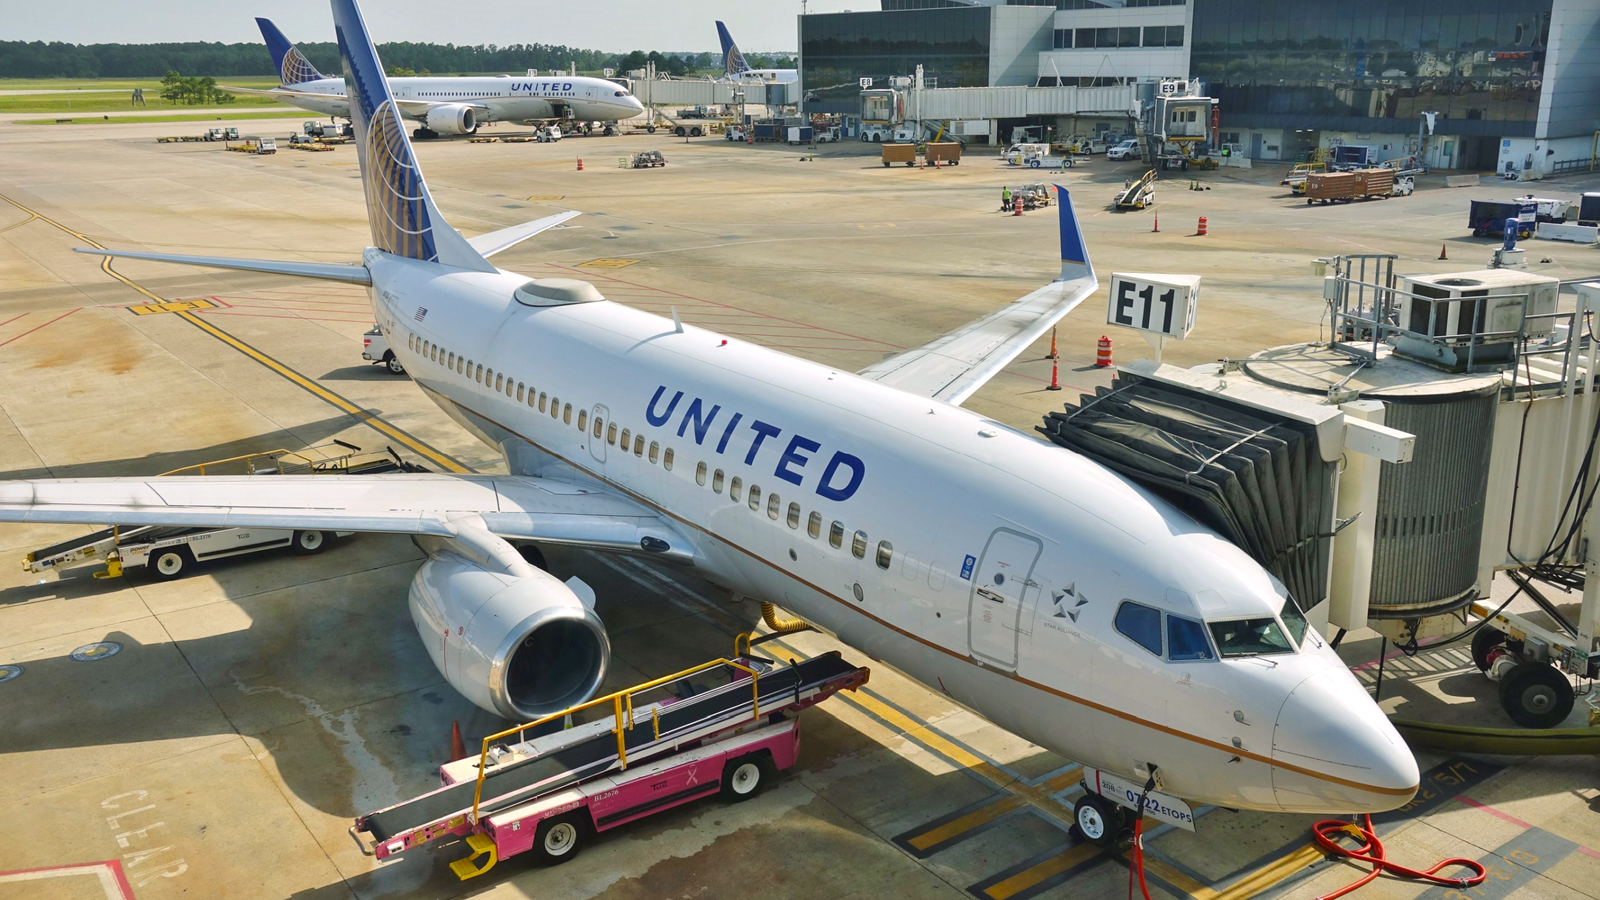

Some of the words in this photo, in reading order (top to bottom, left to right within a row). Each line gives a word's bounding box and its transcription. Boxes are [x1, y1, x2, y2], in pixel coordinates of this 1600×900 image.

[511, 83, 573, 91] UNITED
[861, 78, 871, 86] E8
[1162, 84, 1175, 93] E9
[1115, 280, 1175, 333] E11
[645, 385, 866, 502] UNITED
[130, 544, 150, 552] power
[1043, 622, 1057, 630] STAR
[1056, 627, 1081, 638] ALLIANCE
[594, 789, 619, 802] BL2676
[1161, 806, 1193, 823] ETOPS
[101, 789, 189, 888] CLEAR
